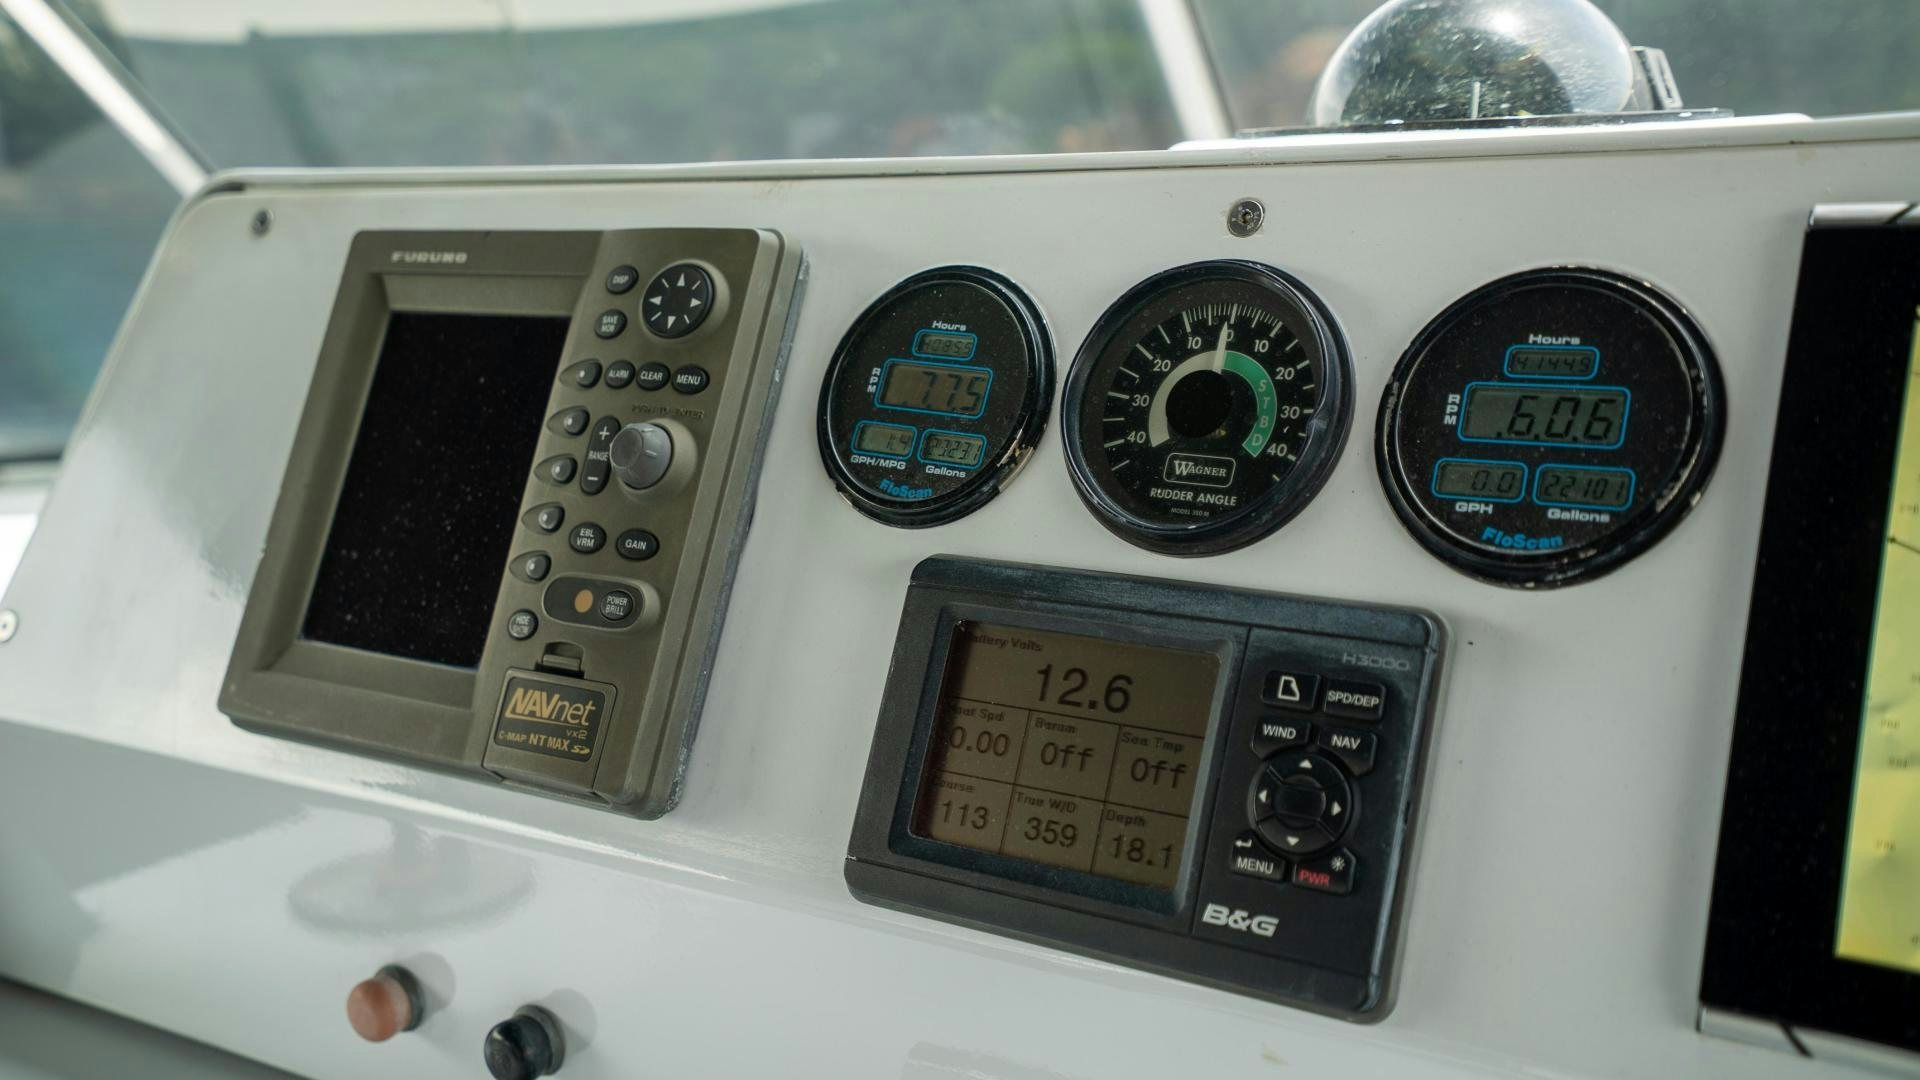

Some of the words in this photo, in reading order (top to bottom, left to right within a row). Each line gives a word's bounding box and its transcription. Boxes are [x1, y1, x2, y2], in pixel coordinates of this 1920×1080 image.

[391, 251, 468, 264] FURUNO
[612, 275, 629, 285] DISP
[602, 315, 618, 325] SAVE
[932, 320, 966, 331] Hours
[1187, 337, 1201, 349] 10
[1254, 339, 1269, 352] 10
[1528, 334, 1580, 346] Hours
[1153, 359, 1171, 372] 20
[608, 369, 629, 379] ALARM
[640, 370, 663, 382] CLEAR
[676, 374, 701, 386] MENU
[1275, 367, 1295, 380] 20
[1132, 394, 1150, 408] 30
[1280, 405, 1300, 419] 30
[1127, 431, 1146, 444] 40
[588, 451, 609, 462] RANGE
[1267, 443, 1288, 457] 40
[850, 454, 906, 470] GPH/MPG
[925, 465, 966, 478] Gallons
[1472, 470, 1516, 493] 0.0
[1544, 474, 1626, 500] 22101
[879, 479, 933, 499] FloScan
[1150, 488, 1193, 501] RUDDER
[1197, 492, 1237, 506] ANGLE
[1455, 502, 1493, 515] GPH
[1547, 508, 1610, 523] Gallons
[580, 528, 594, 537] EBL
[1482, 527, 1563, 550] FloScan
[576, 537, 594, 548] VRM
[625, 539, 646, 551] GAIN
[607, 596, 627, 606] POWER
[605, 605, 624, 616] BRILL
[971, 632, 1009, 648] attery
[1341, 653, 1410, 671] H3000
[1036, 663, 1134, 714] 12.6
[1327, 690, 1379, 708] SPD/DEP
[505, 687, 596, 726] NAVnet
[979, 708, 1005, 722] Spd
[1262, 724, 1297, 740] WIND
[498, 730, 527, 743] C-MAP
[529, 734, 547, 746] NT
[548, 736, 570, 752] MAX
[949, 726, 1010, 757] 0.00
[1121, 731, 1149, 746] Sea
[1154, 737, 1184, 753] Tmp
[1331, 735, 1361, 750] NAV
[942, 801, 989, 830] 113
[1105, 808, 1146, 828] Depth
[1024, 816, 1078, 848] 359
[1112, 833, 1174, 869] 18.1
[1236, 857, 1274, 874] MENU
[1299, 870, 1330, 886] PWR
[1202, 903, 1280, 938] B&G
